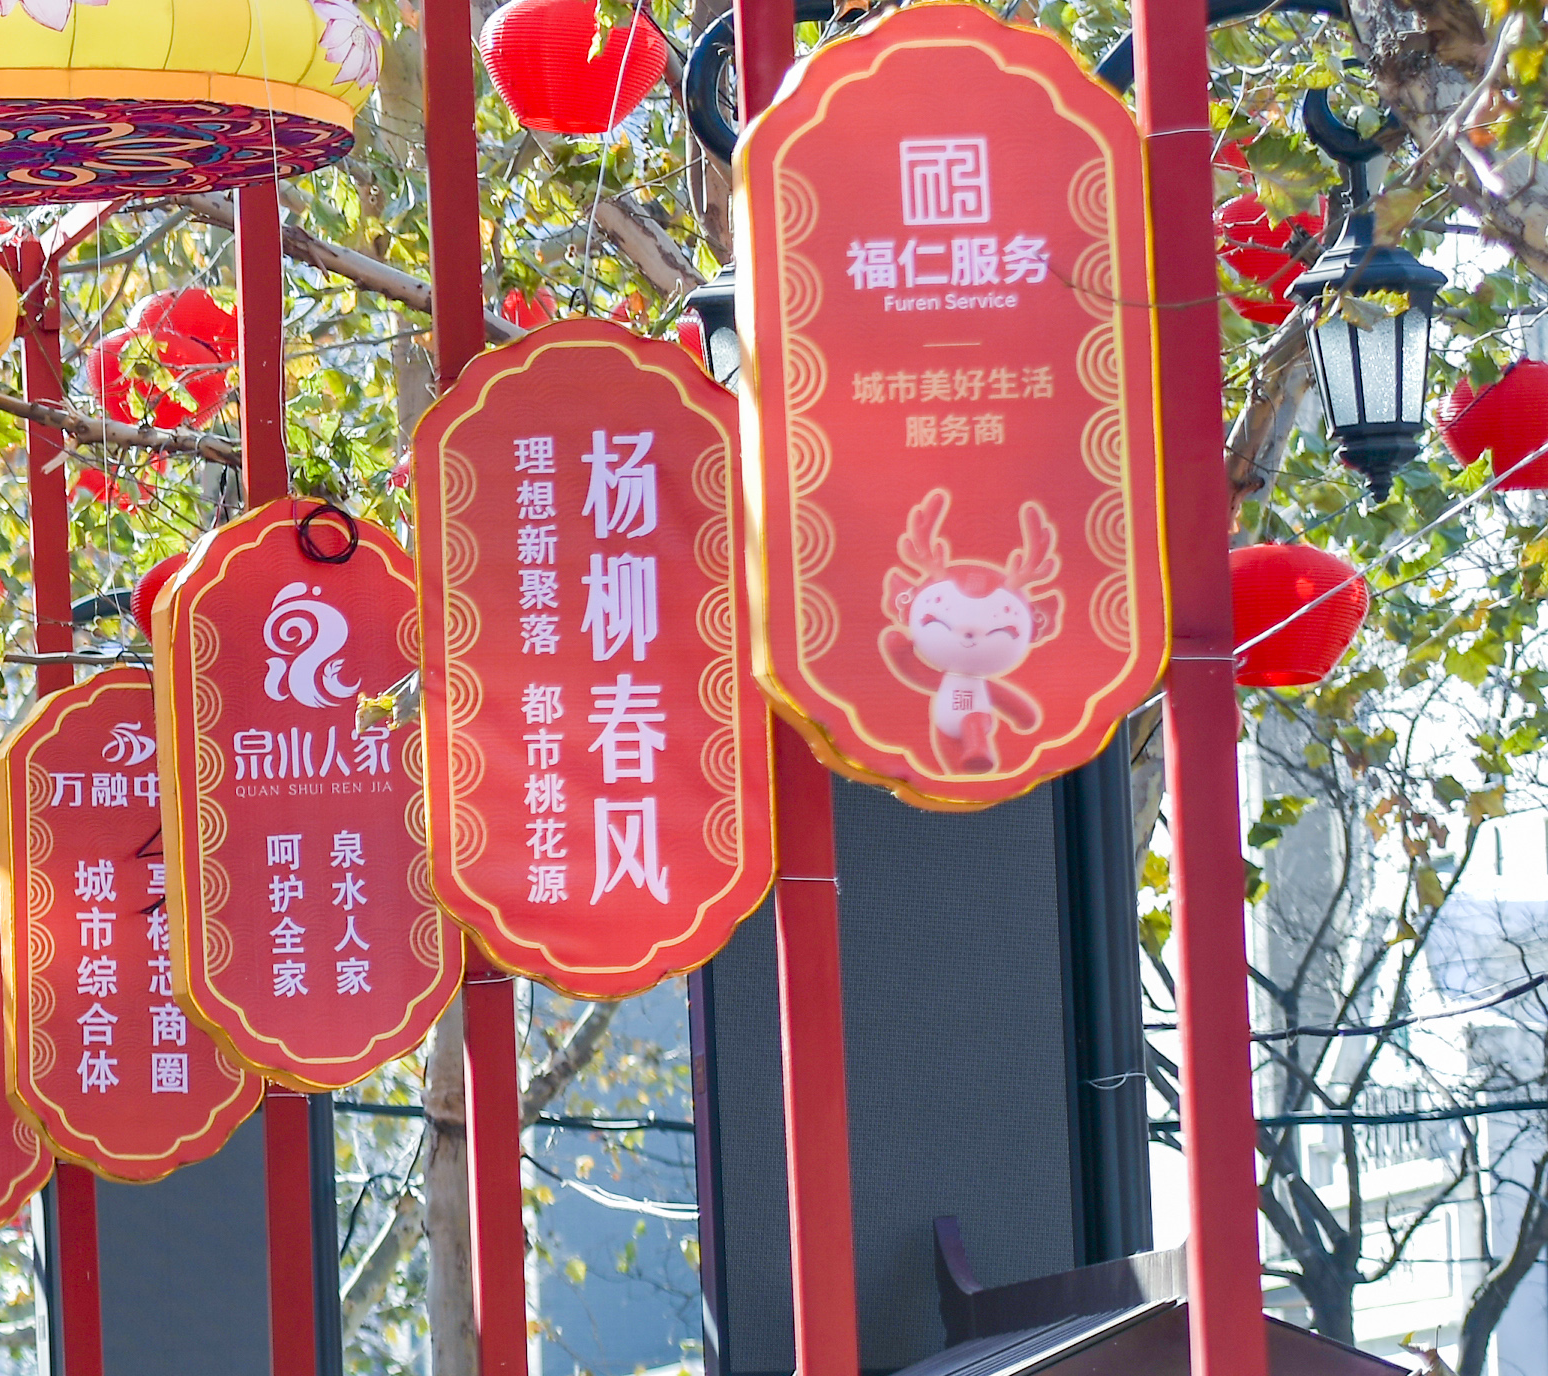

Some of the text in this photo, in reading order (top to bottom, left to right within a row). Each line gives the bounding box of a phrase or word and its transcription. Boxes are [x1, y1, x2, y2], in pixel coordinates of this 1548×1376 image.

[846, 234, 1050, 290] 福仁服务
[883, 291, 1018, 312] Furen Service
[851, 365, 1053, 405] 城市美好生活
[905, 412, 1004, 448] 服务商
[513, 436, 569, 904] 理想新聚落 都市桃花源
[580, 430, 670, 906] 杨柳春风
[231, 722, 392, 782] 泉水人家
[235, 780, 393, 799] QUAN SHUI REN JIA
[266, 833, 309, 998] 呵护全家
[329, 829, 372, 996] 泉水人家
[74, 858, 120, 1094] 城市综合体
